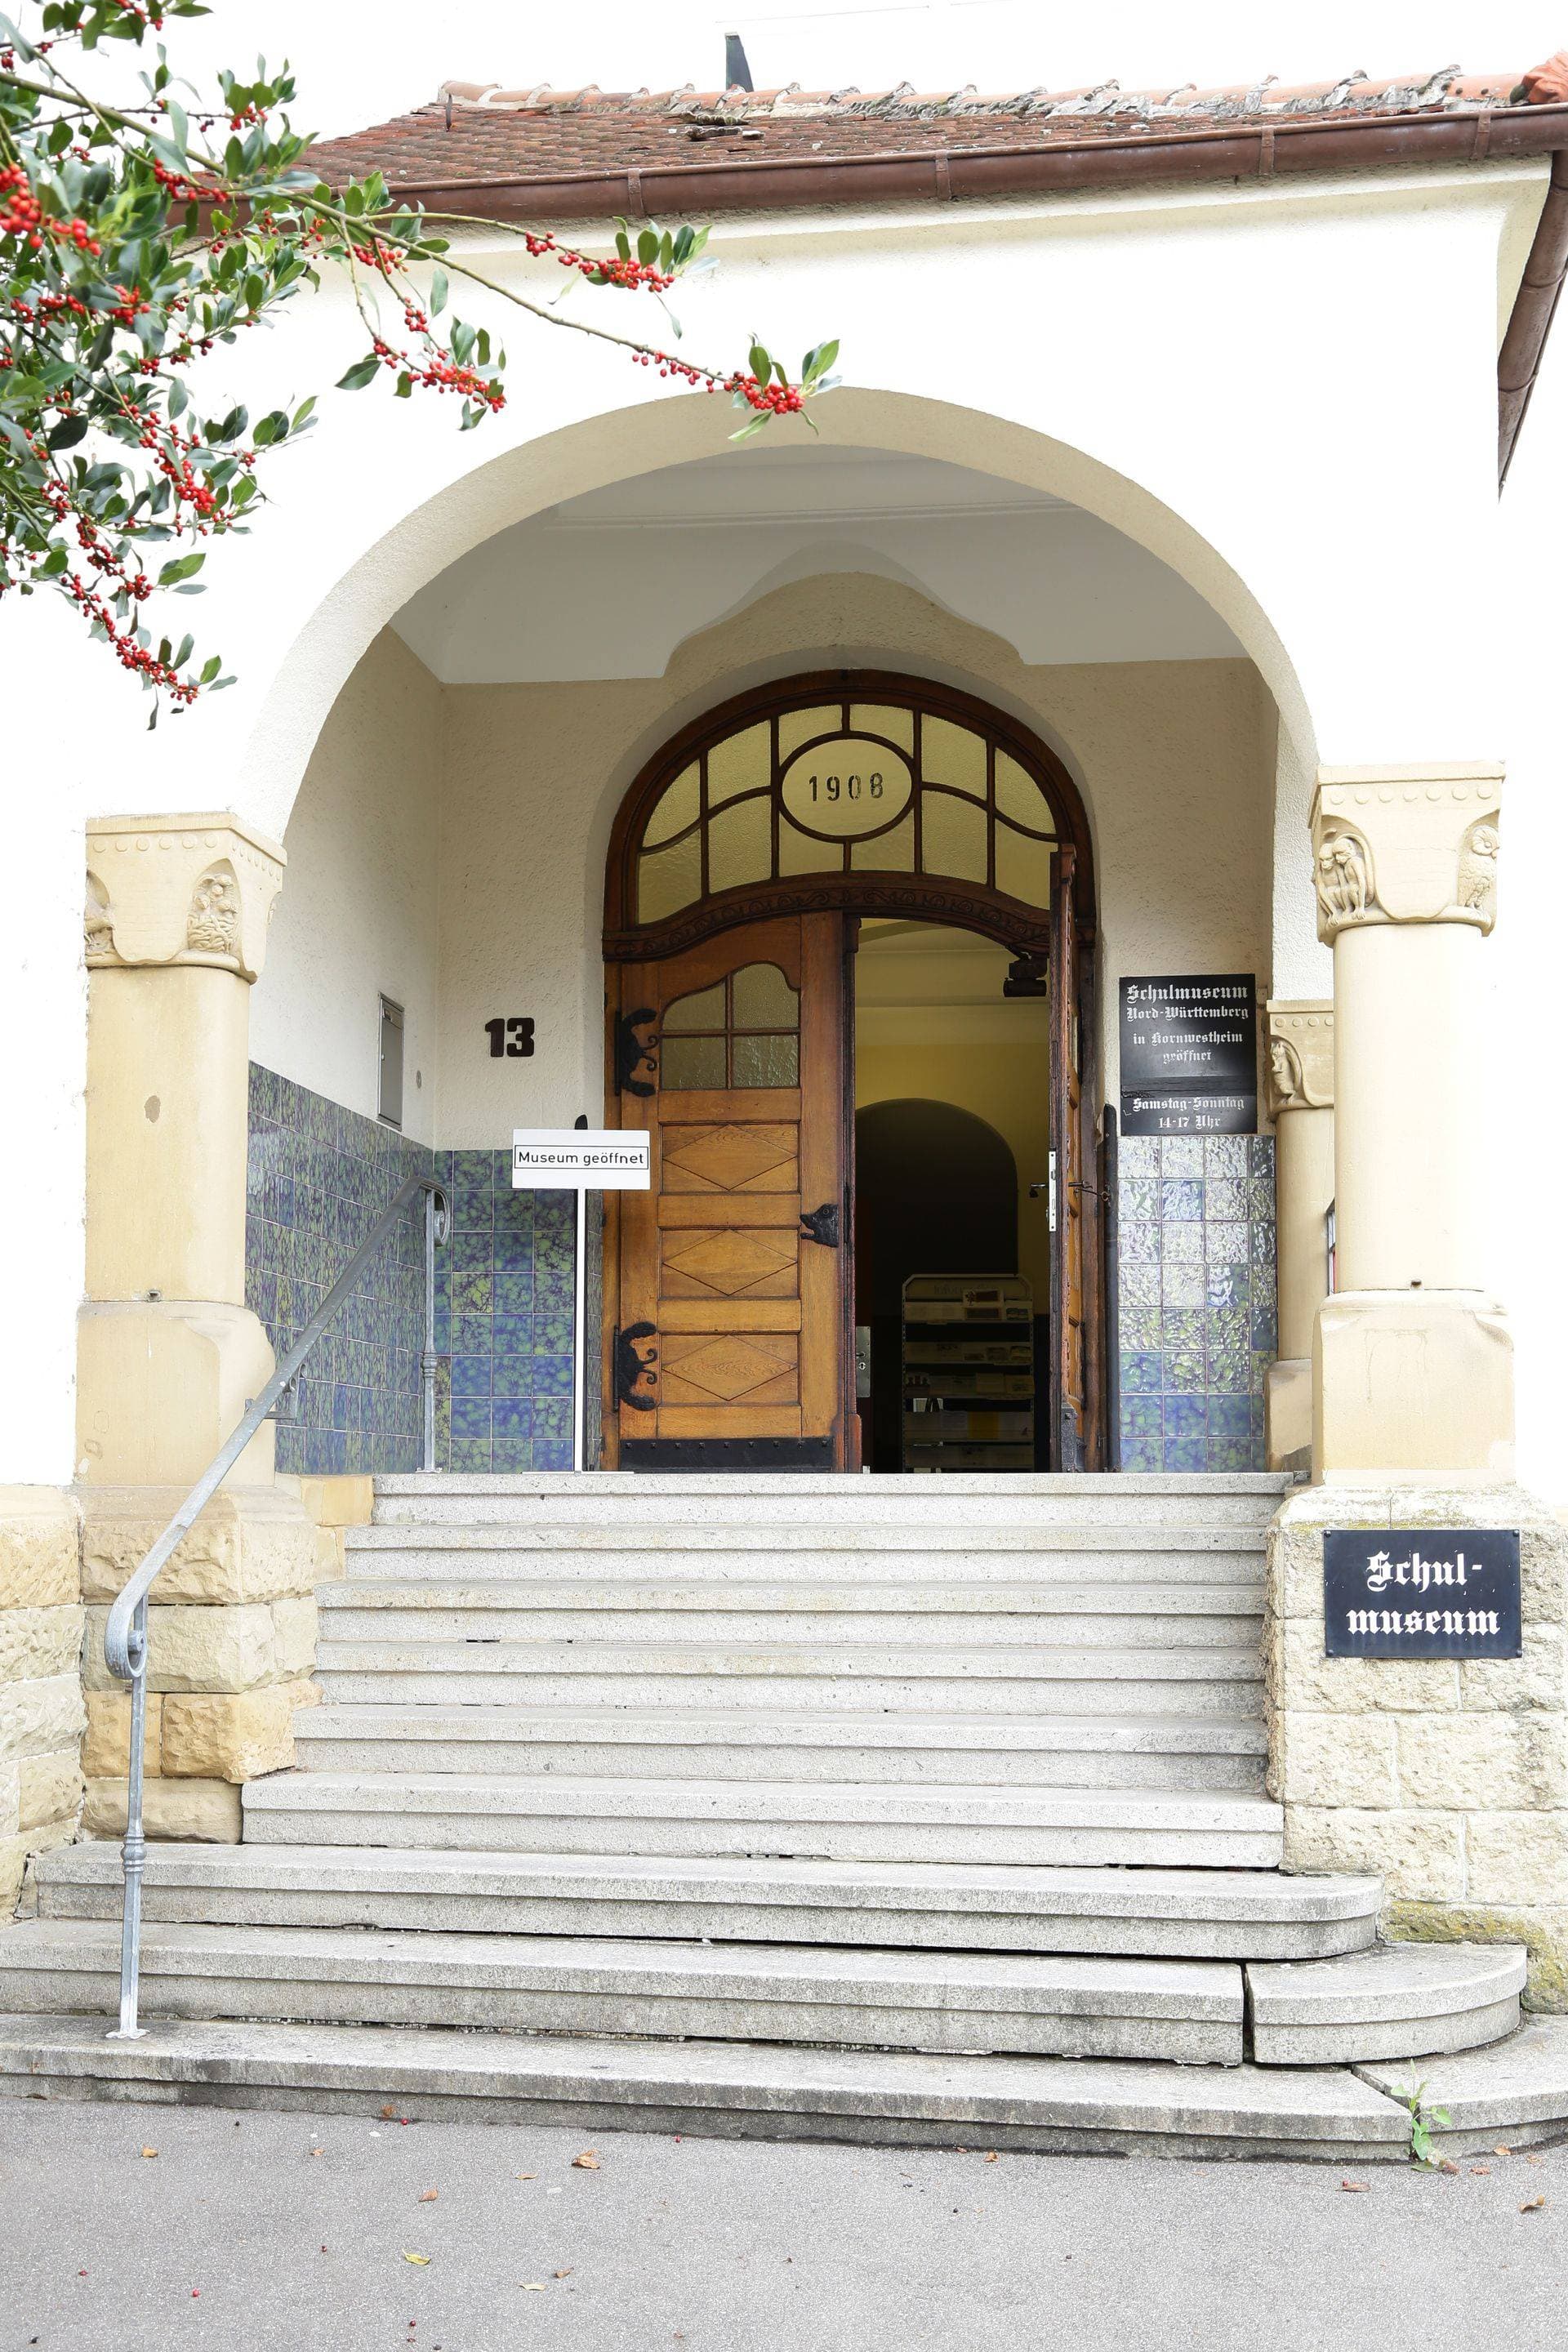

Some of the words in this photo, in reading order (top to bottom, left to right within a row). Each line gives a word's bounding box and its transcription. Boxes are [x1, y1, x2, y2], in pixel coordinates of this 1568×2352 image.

[808, 773, 884, 802] 1908
[1126, 984, 1249, 1004] Schulmuseum
[1126, 1006, 1249, 1022] Nord-Württemberg
[484, 1018, 535, 1058] 13
[1133, 1033, 1145, 1045] in
[1152, 1031, 1243, 1046] Kornwestheim
[1133, 1096, 1245, 1112] Samstag-Sonntag
[1158, 1116, 1190, 1129] 14-17
[1195, 1115, 1221, 1129] Uhr
[519, 1152, 578, 1164] Museum
[583, 1152, 644, 1166] geöffnet
[1365, 1550, 1483, 1593] Schul-
[1346, 1609, 1501, 1636] museum
